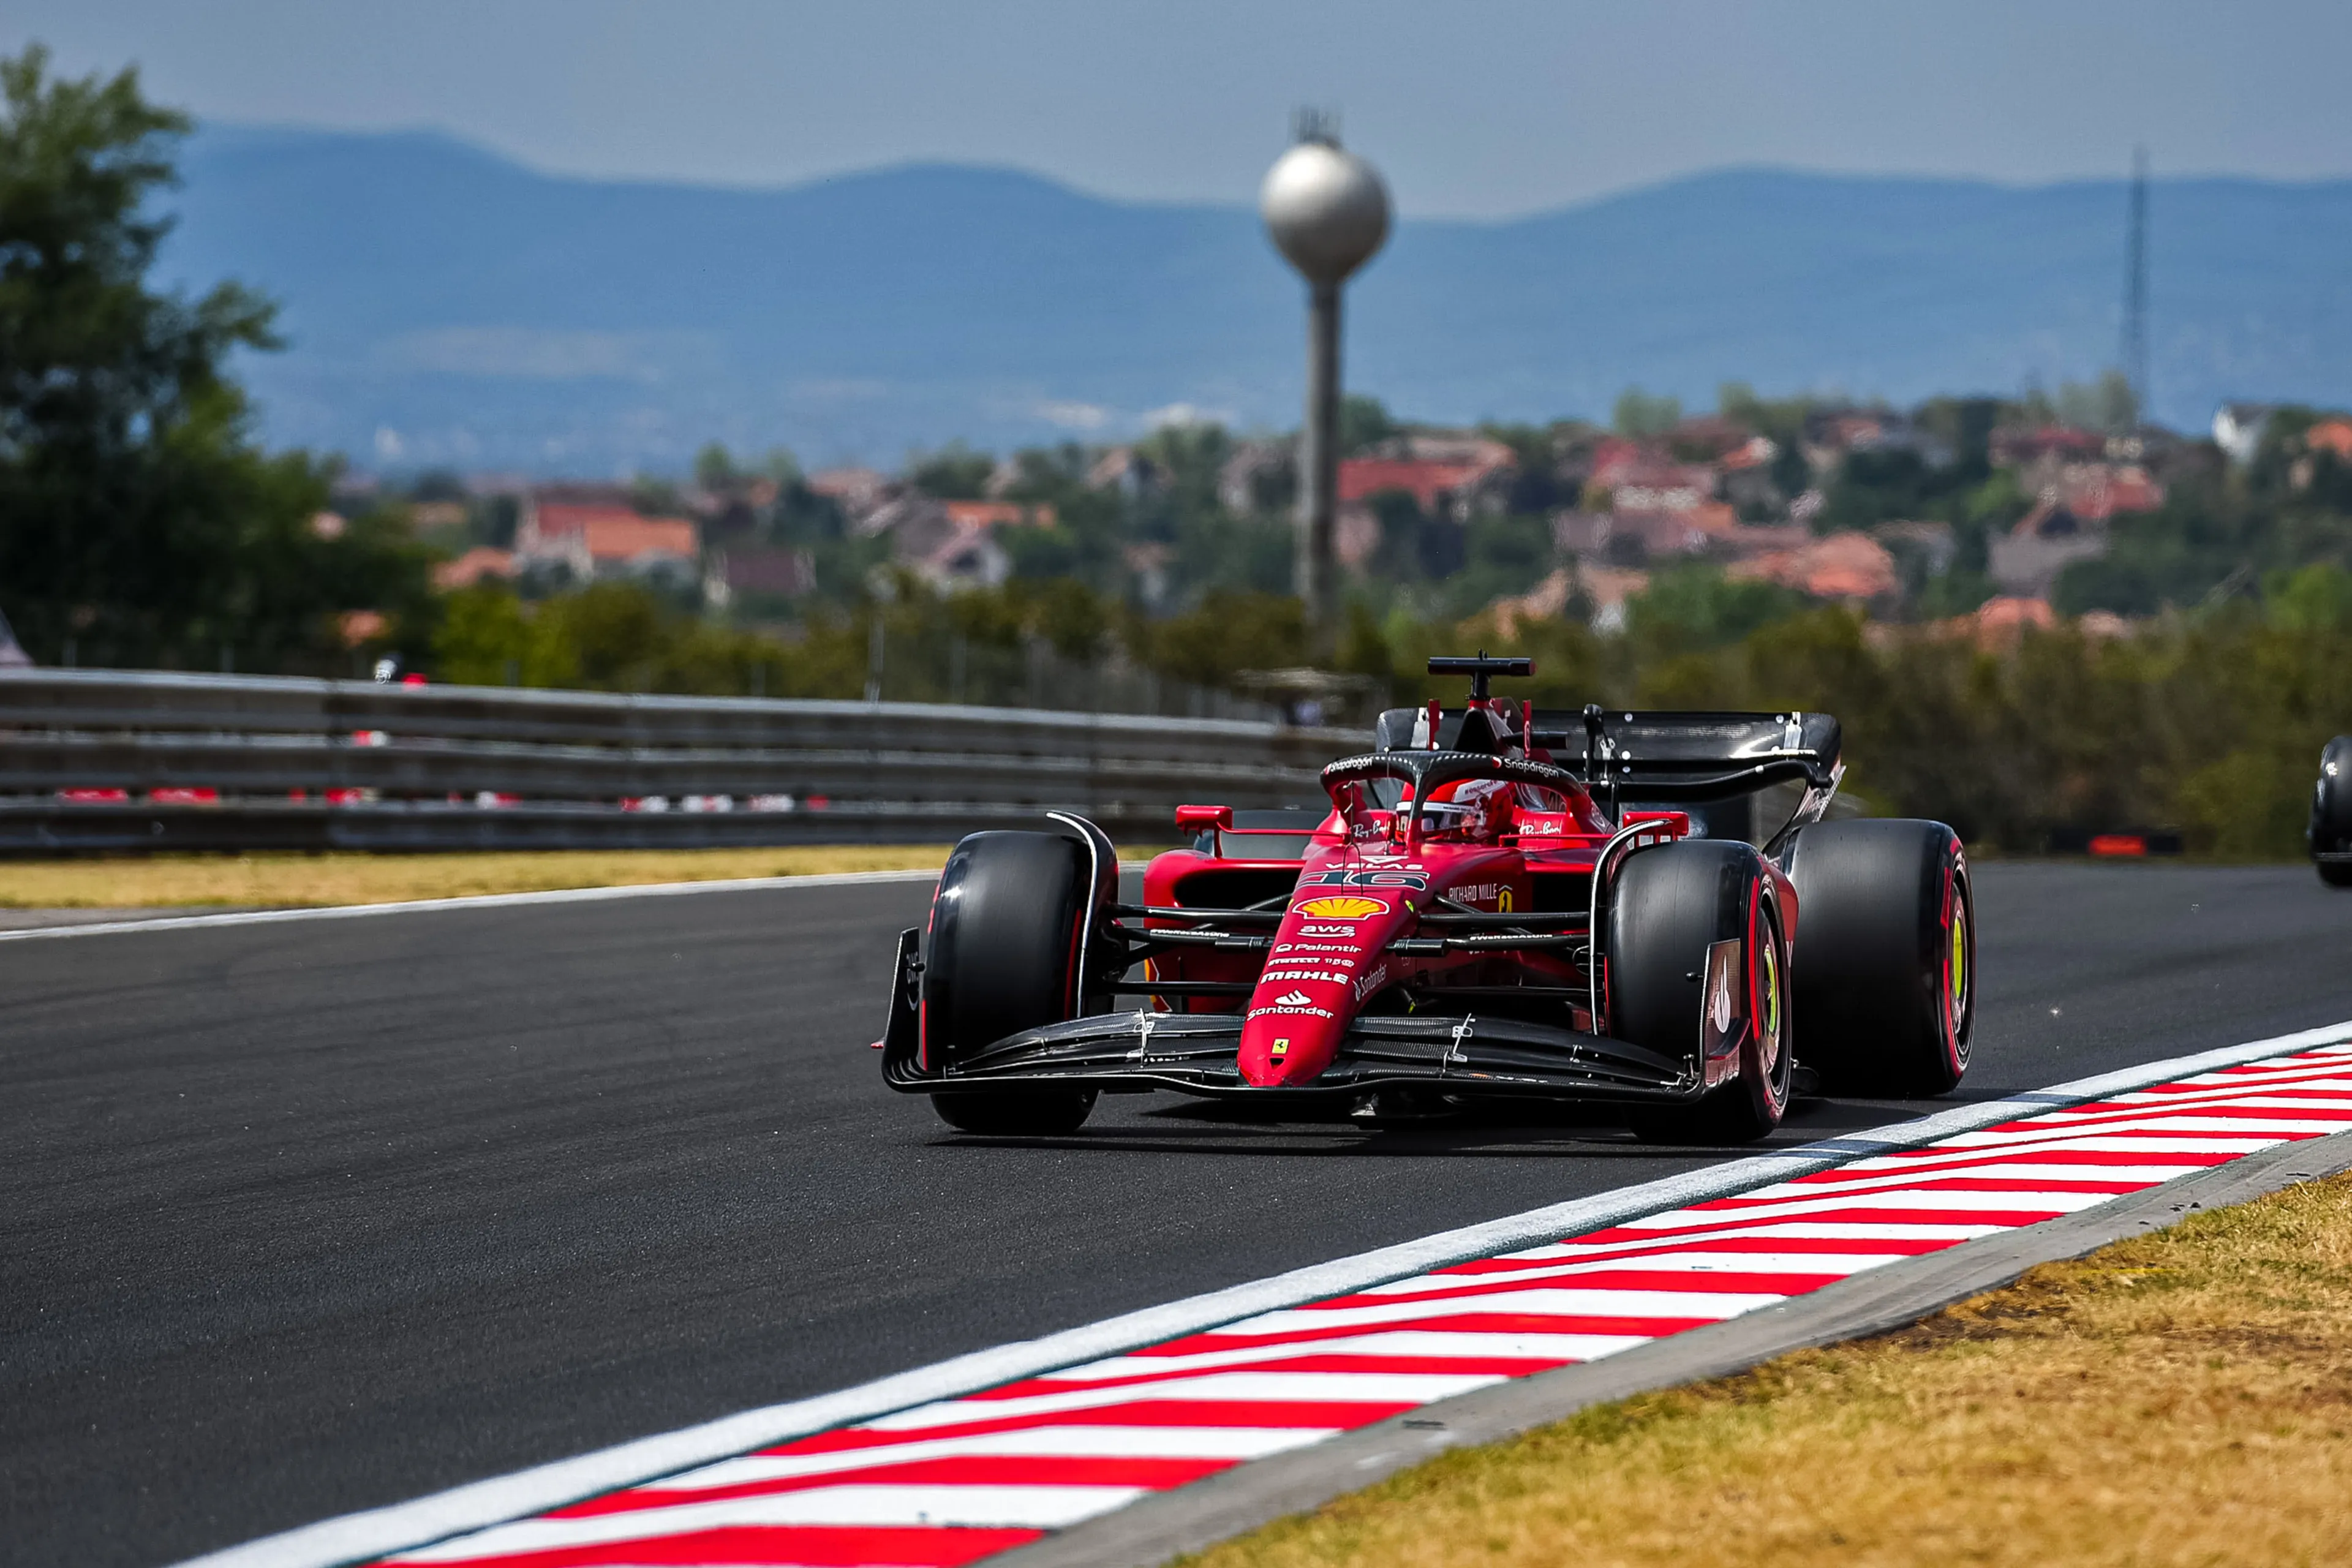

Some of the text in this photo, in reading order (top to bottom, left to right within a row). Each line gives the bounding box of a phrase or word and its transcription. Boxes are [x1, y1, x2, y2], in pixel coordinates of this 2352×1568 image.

[1504, 758, 1559, 777] Snapdragon
[1295, 869, 1430, 891] 16
[1449, 883, 1498, 902] RICHARD MILLE
[1294, 944, 1362, 953] Palantir
[1260, 971, 1349, 986] MAHLE
[1361, 963, 1387, 997] Santander
[1246, 1006, 1334, 1022] Santander
